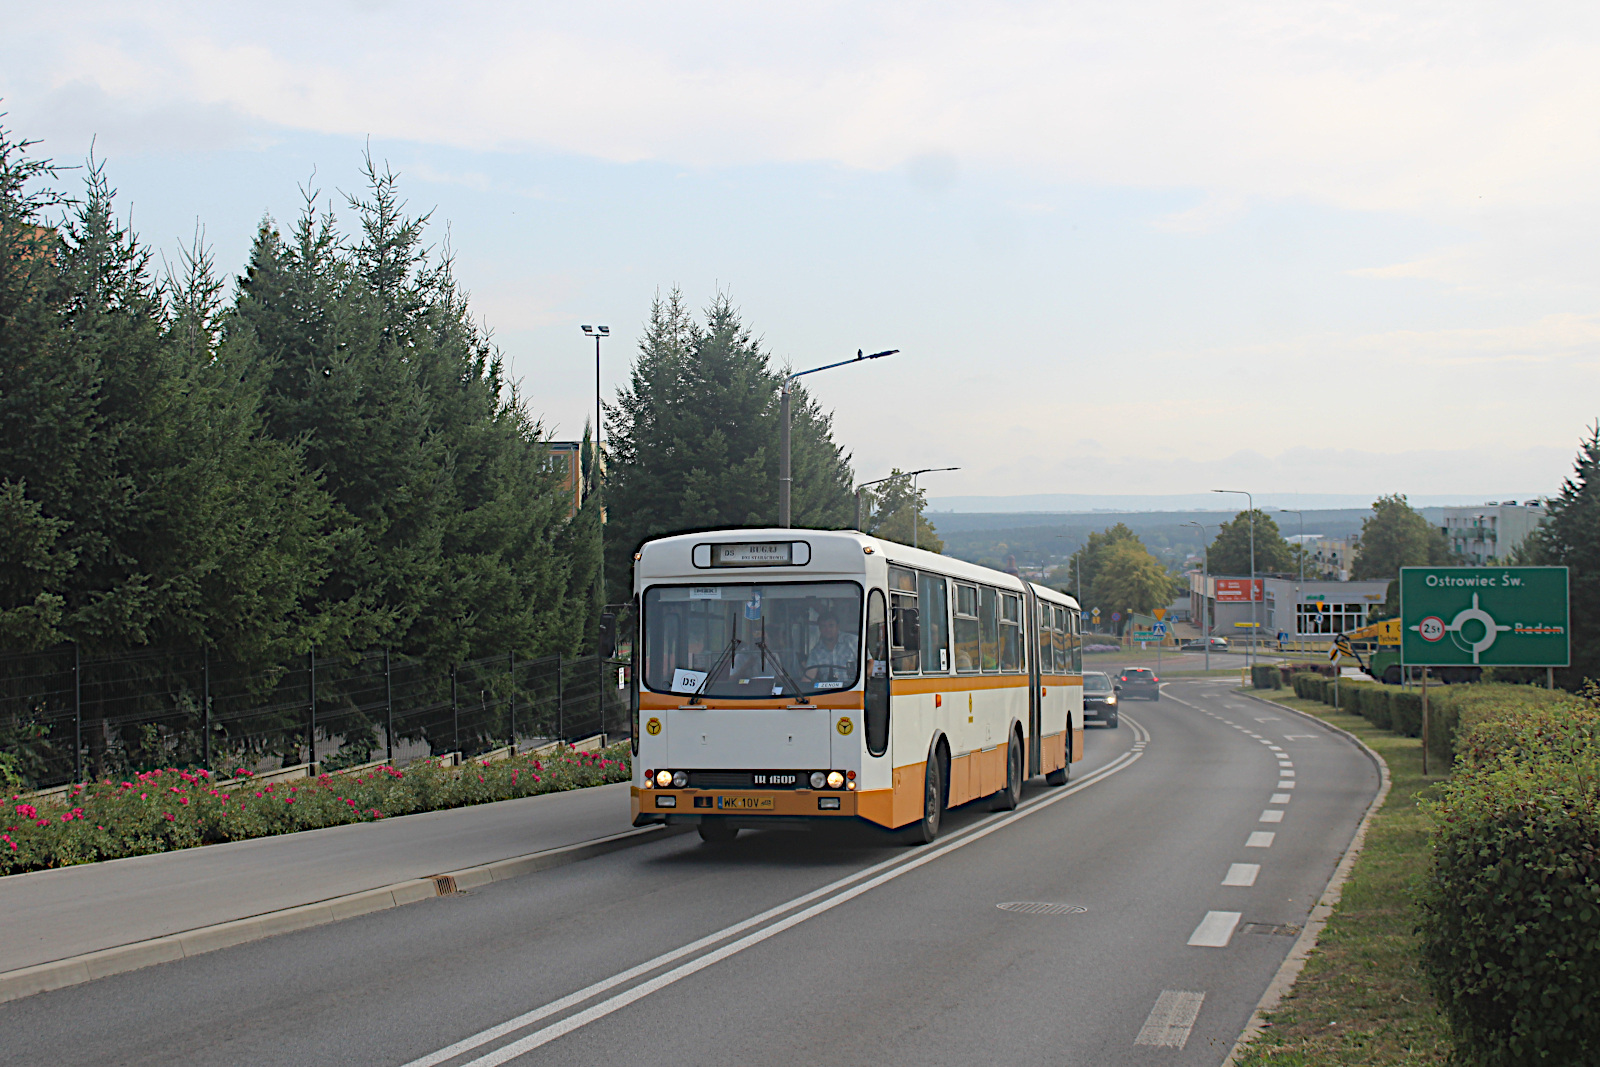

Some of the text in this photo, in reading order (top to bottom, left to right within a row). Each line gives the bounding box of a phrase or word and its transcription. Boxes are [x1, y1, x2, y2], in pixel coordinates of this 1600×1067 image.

[724, 549, 735, 557] DS
[1425, 571, 1525, 587] Ostrowiec Św.
[1514, 622, 1565, 635] Radom
[682, 677, 696, 687] DS
[769, 775, 796, 784] 160P
[724, 797, 738, 808] WK
